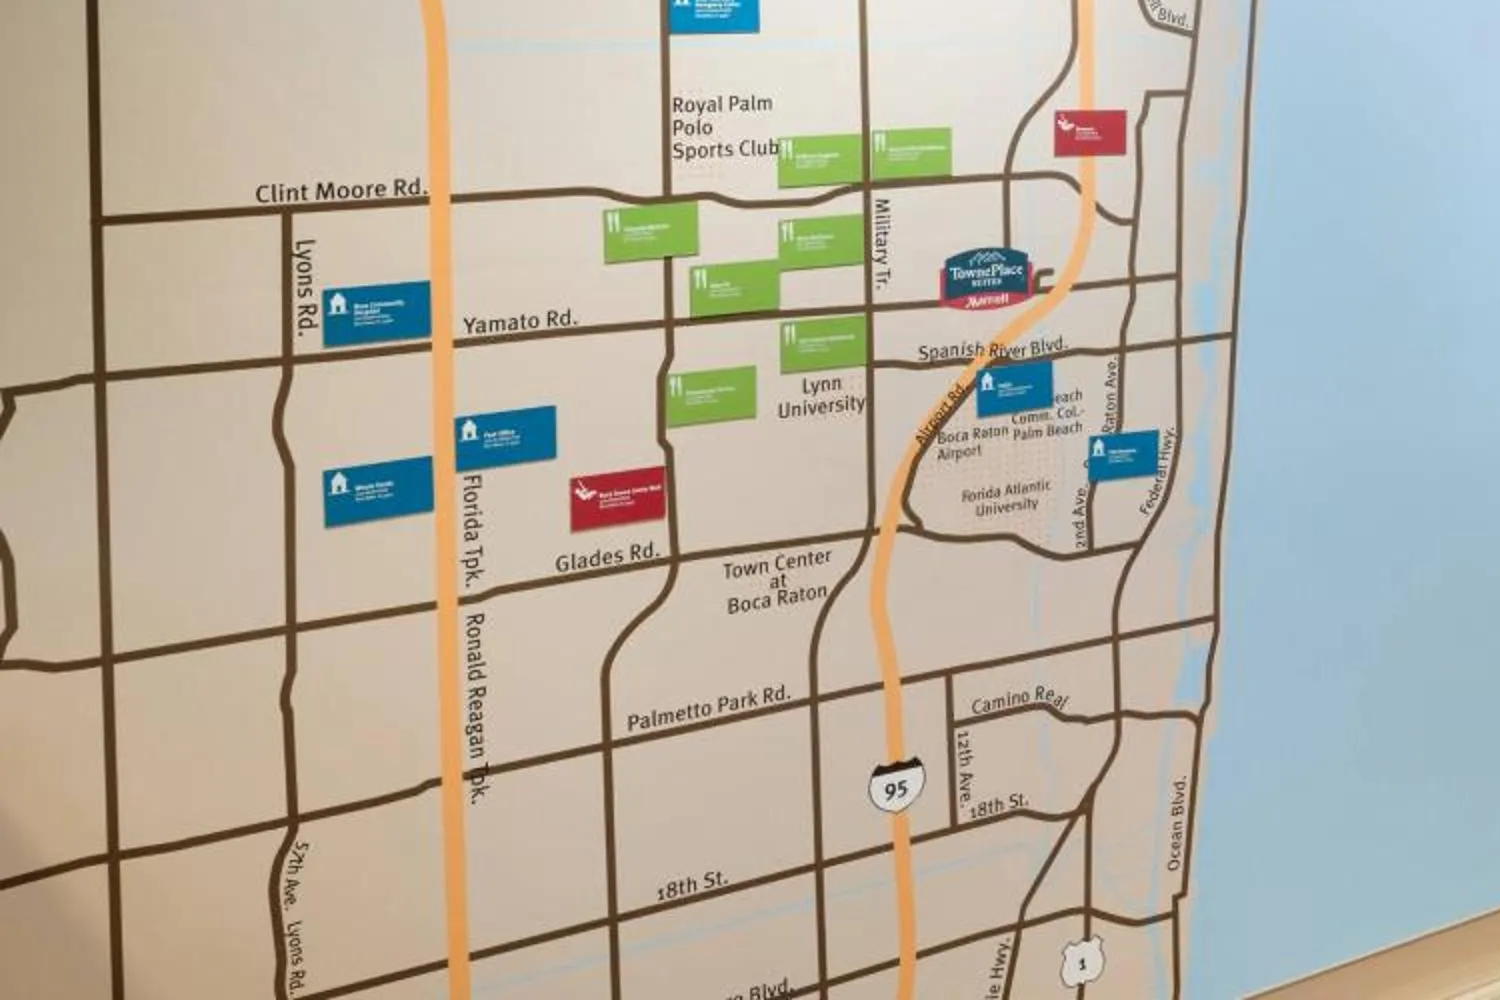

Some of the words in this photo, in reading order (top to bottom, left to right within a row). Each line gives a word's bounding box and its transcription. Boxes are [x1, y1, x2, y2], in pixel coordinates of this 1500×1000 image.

[1158, 7, 1190, 28] Blvd.
[673, 95, 722, 117] Royal
[728, 93, 773, 112] Palm
[673, 118, 713, 137] Polo
[673, 140, 732, 162] Sports
[739, 137, 780, 156] Club
[256, 183, 308, 204] Clint
[315, 180, 386, 202] Moore
[393, 177, 428, 198] Rd.
[872, 199, 891, 264] Military
[291, 239, 316, 299] Lyons
[875, 267, 892, 289] Tr.
[949, 264, 1024, 280] TownePlace
[297, 304, 317, 338] Rd.
[463, 314, 541, 335] Yamato
[547, 309, 578, 328] Rd.
[918, 341, 985, 362] Spanish
[989, 343, 1027, 358] River
[1030, 336, 1068, 352] Blvd.
[802, 377, 841, 396] Lynn
[1105, 357, 1118, 388] Ave.
[778, 396, 866, 419] University
[1055, 388, 1083, 403] each
[916, 401, 951, 445] Airport
[948, 383, 967, 402] Rd.
[1103, 393, 1117, 433] Raton
[937, 430, 969, 445] Boca
[973, 425, 1009, 440] Raton
[1013, 428, 1043, 441] Palm
[1047, 421, 1083, 435] Beach
[937, 445, 982, 463] Airport
[1139, 465, 1168, 516] Federal
[1160, 427, 1175, 463] Hwy.
[1004, 479, 1051, 495] Atlantic
[1073, 484, 1089, 517] Ave.
[463, 475, 483, 541] Florida
[975, 498, 1039, 517] University
[1072, 520, 1088, 549] 2nd
[461, 546, 484, 588] Tpk.
[555, 548, 624, 572] Glades
[630, 543, 661, 562] Rd.
[723, 558, 768, 581] Town
[772, 548, 833, 573] Center
[769, 573, 788, 589] at
[727, 594, 773, 615] Boca
[777, 584, 827, 606] Raton
[466, 612, 486, 682] Ronald
[627, 700, 713, 732] Palmetto
[718, 692, 757, 713] Park
[761, 685, 791, 704] Rd.
[971, 690, 1030, 714] Camino
[1035, 685, 1070, 711] Real
[465, 686, 487, 760] Reagan
[957, 730, 974, 767] 12th
[470, 761, 491, 806] Tpk.
[884, 780, 908, 799] 95
[960, 772, 974, 808] Ave.
[1171, 775, 1187, 816] Blvd.
[970, 797, 1004, 820] 18th
[1009, 793, 1029, 810] St.
[1167, 819, 1184, 871] Ocean
[284, 878, 300, 911] Ave.
[657, 877, 699, 901] 18th
[703, 870, 729, 889] St.
[285, 920, 303, 966] Lyons
[989, 938, 1010, 979] Hwy.
[1079, 959, 1087, 970] 1
[290, 970, 306, 995] Rd.
[750, 976, 794, 1000] Blvd.
